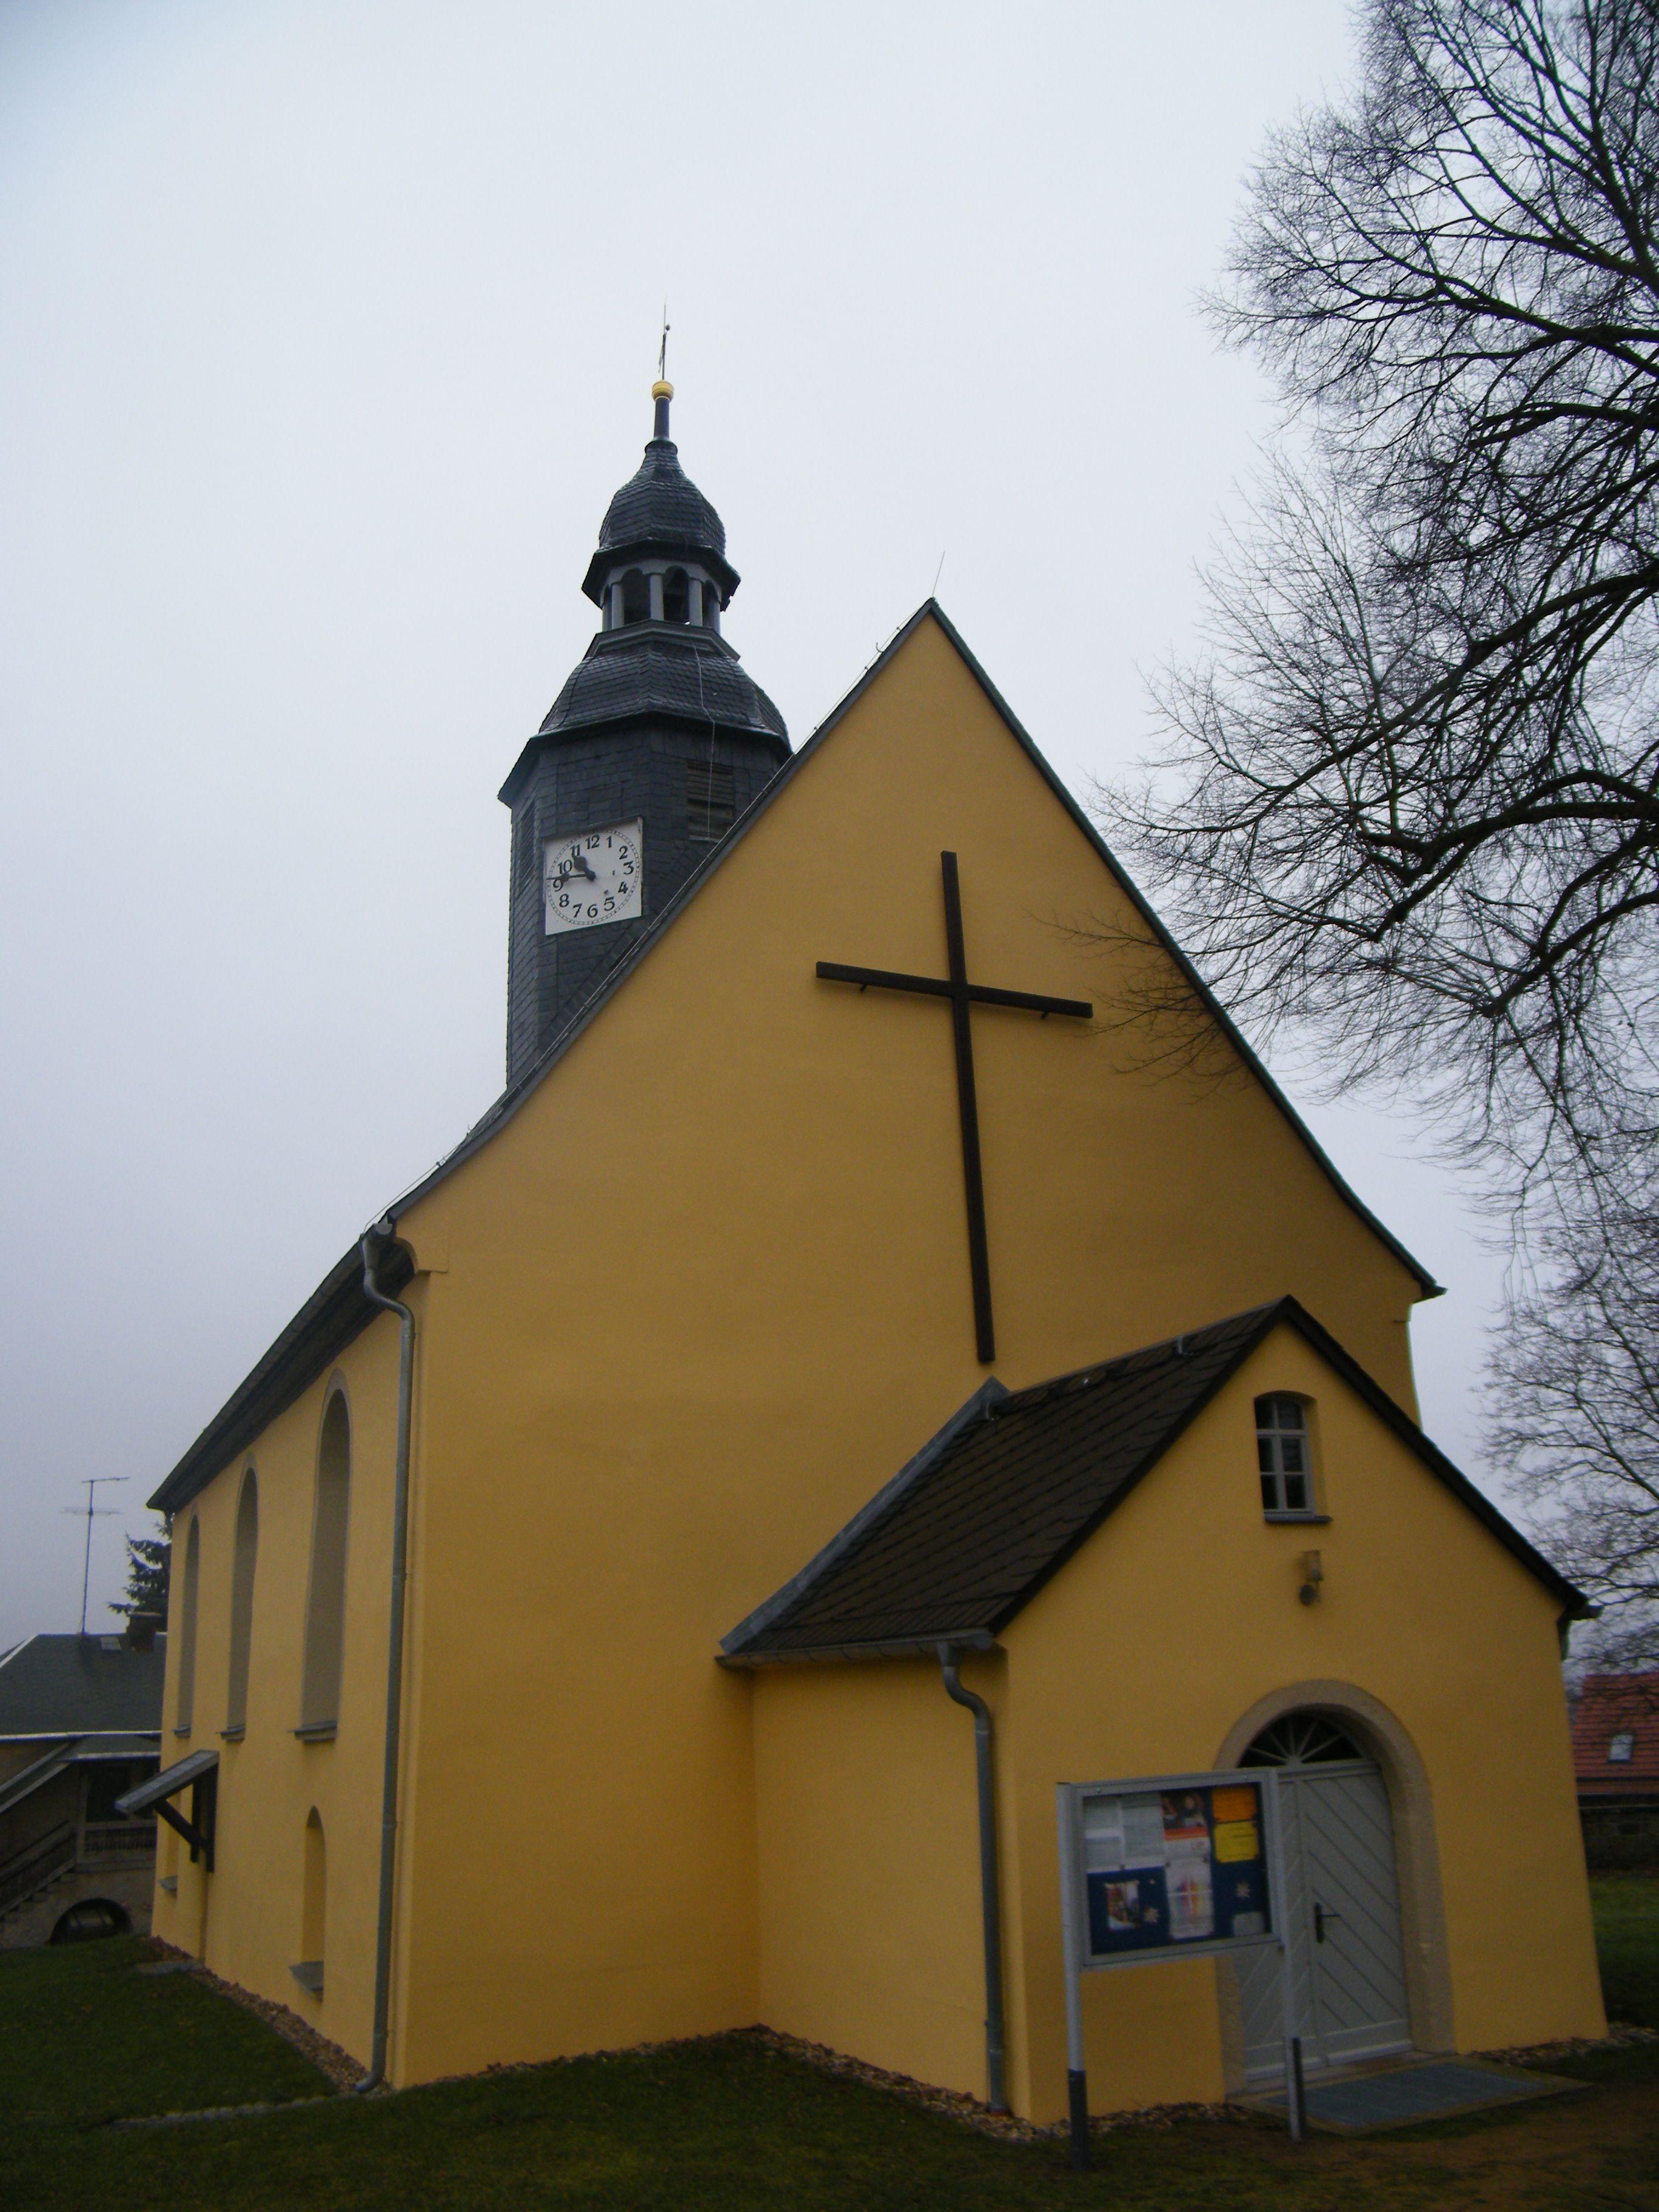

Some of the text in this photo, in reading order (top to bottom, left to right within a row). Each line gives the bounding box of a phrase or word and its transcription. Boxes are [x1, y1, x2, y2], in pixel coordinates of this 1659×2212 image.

[585, 834, 600, 850] 12
[606, 836, 612, 848] 1
[570, 844, 580, 857] 11
[619, 846, 628, 860] 2
[558, 860, 572, 874] 10
[623, 861, 634, 874] 3
[553, 878, 563, 892] 9
[618, 882, 628, 894] 4
[560, 894, 569, 907] 8
[604, 897, 615, 911] 5
[573, 903, 582, 917] 7
[588, 904, 598, 917] 6
